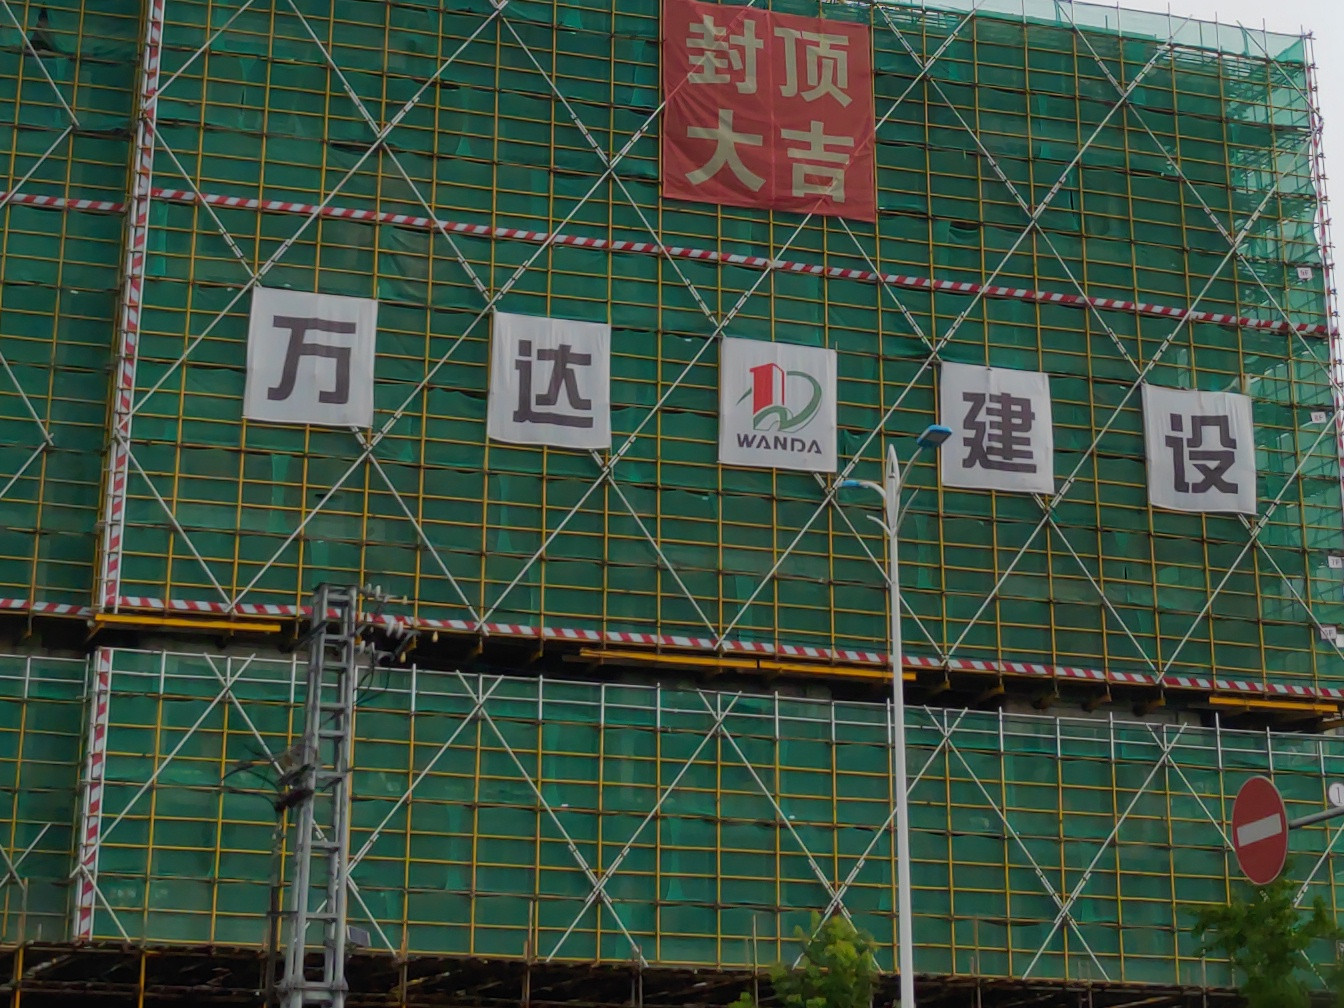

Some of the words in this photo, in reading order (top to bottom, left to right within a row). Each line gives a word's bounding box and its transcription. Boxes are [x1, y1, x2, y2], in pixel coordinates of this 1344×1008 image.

[685, 14, 853, 108] 封顶
[684, 108, 855, 203] 大吉
[736, 433, 823, 455] WANDA
